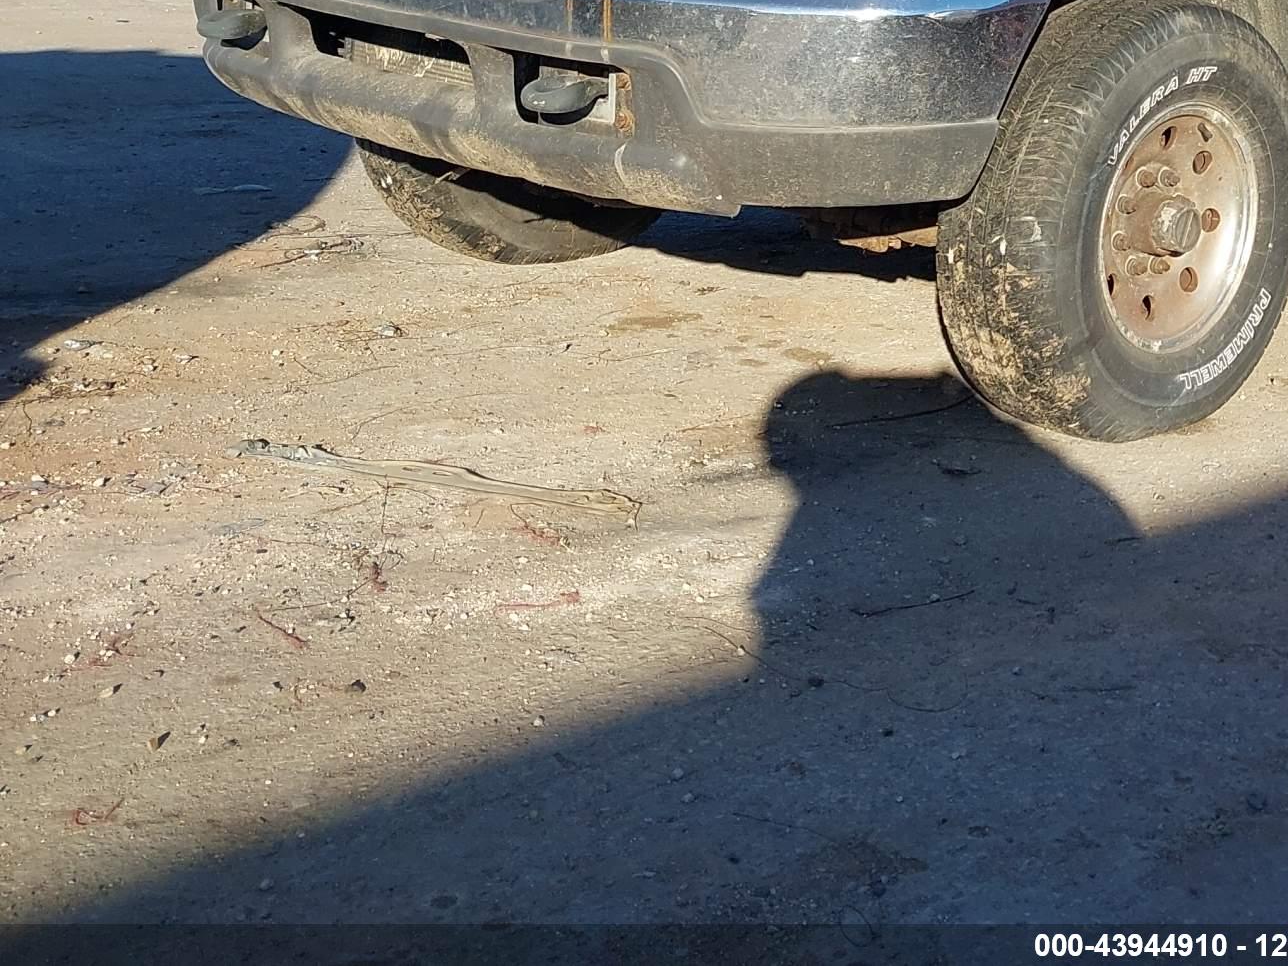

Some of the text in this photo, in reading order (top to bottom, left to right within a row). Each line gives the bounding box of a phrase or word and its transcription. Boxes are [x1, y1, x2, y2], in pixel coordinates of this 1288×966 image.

[1107, 65, 1218, 166] VALERA HT
[1179, 287, 1272, 390] PRIMEWELL
